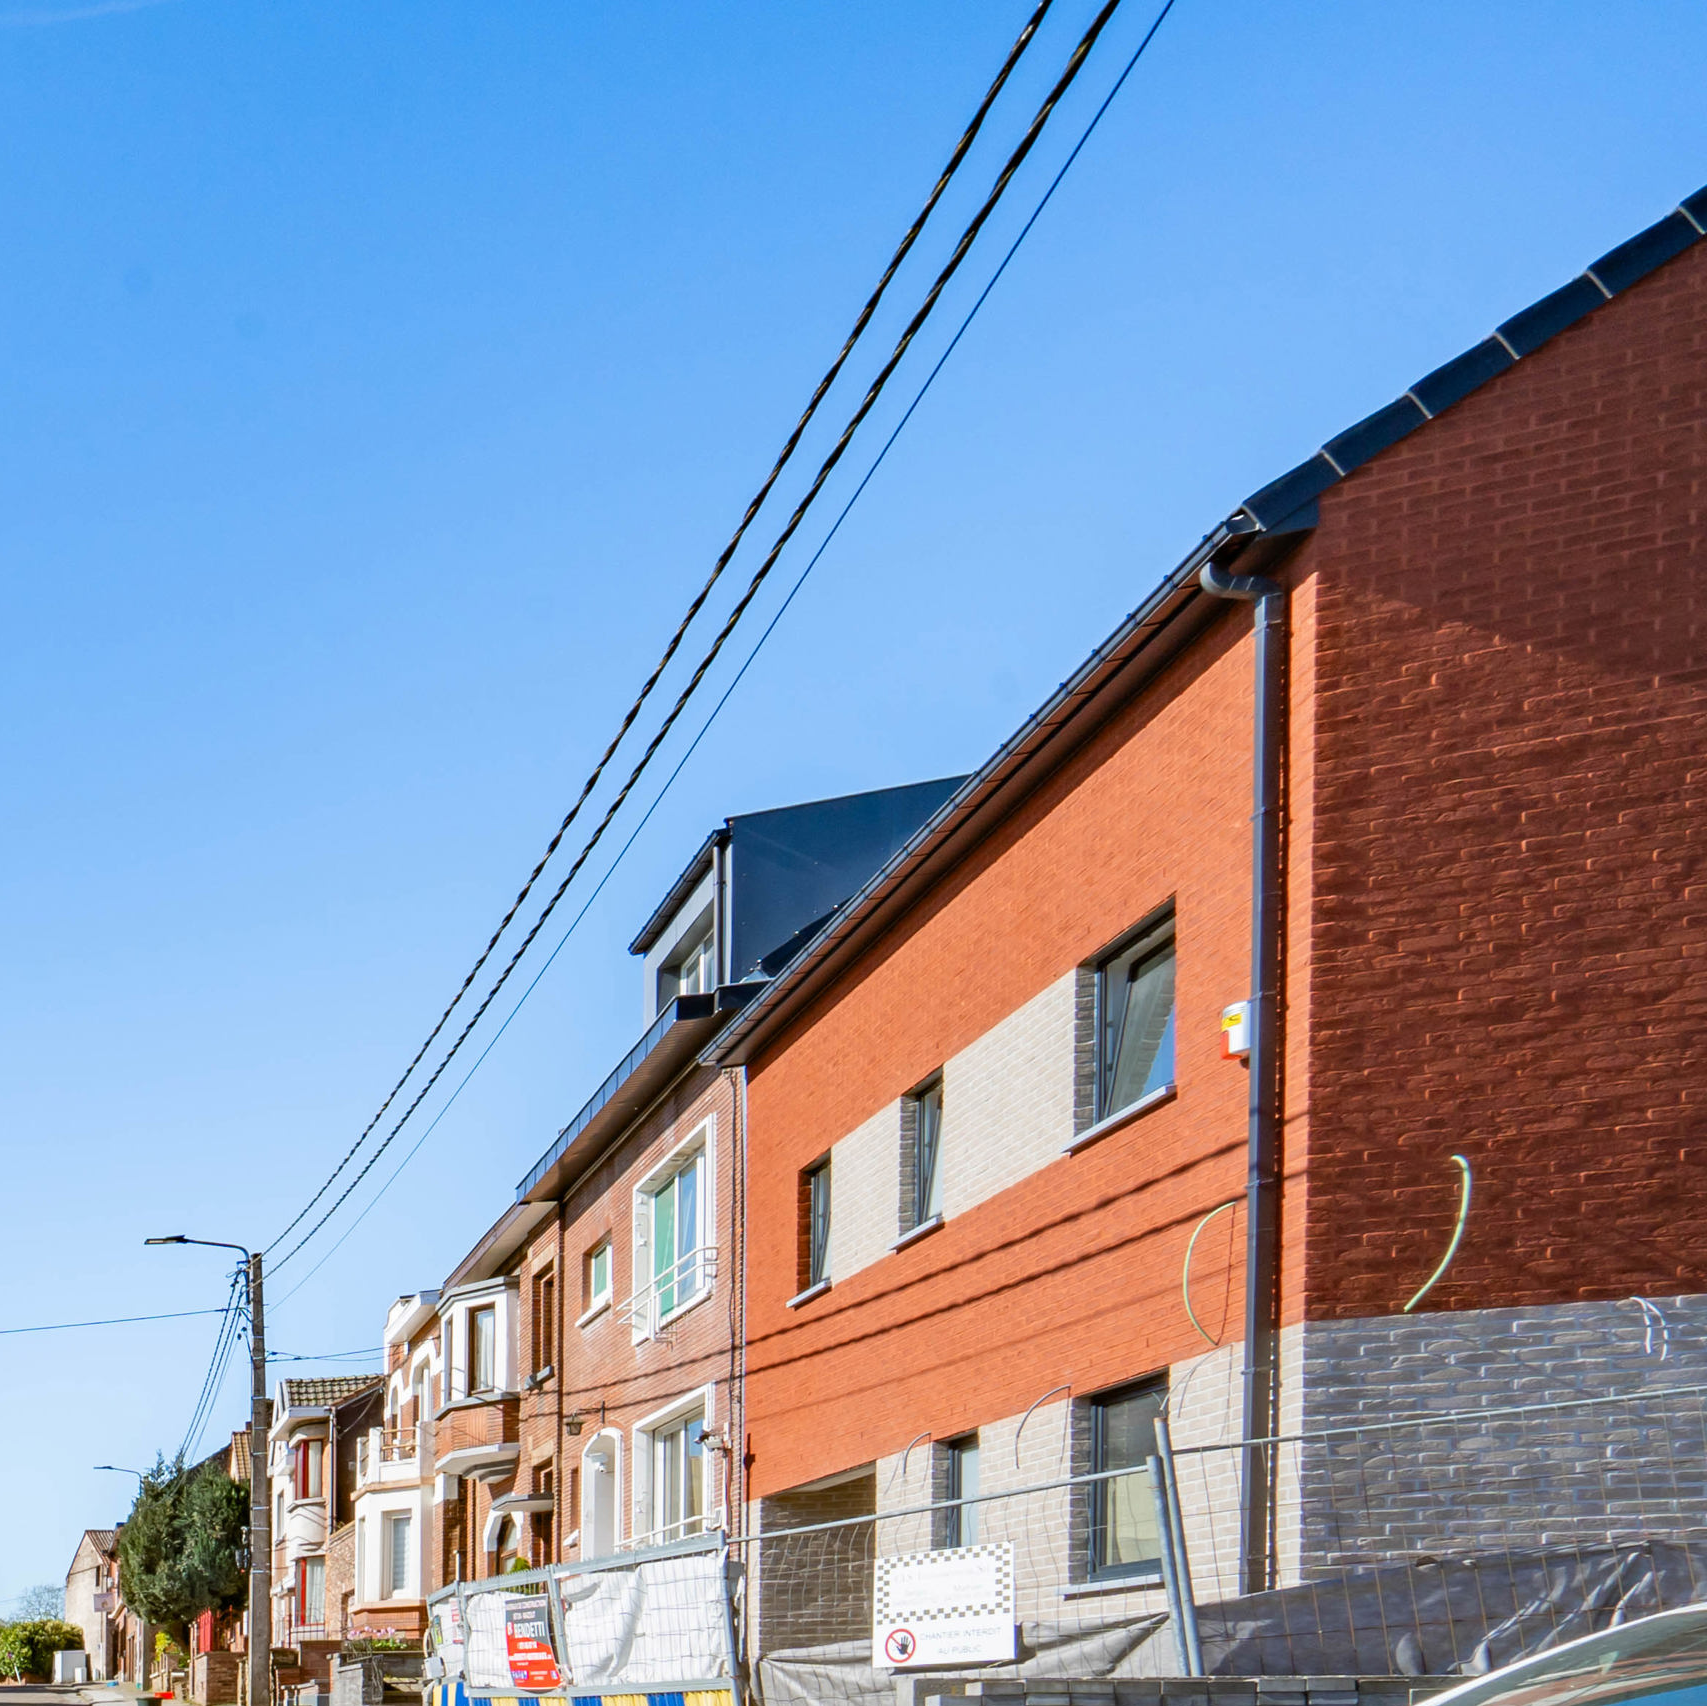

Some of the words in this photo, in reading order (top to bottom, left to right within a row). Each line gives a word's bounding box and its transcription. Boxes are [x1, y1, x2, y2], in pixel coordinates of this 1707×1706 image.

[919, 1630, 960, 1641] CHANTIER
[963, 1626, 1002, 1637] INTERDIT
[938, 1647, 950, 1655] AU
[951, 1643, 982, 1654] PUBLIC
